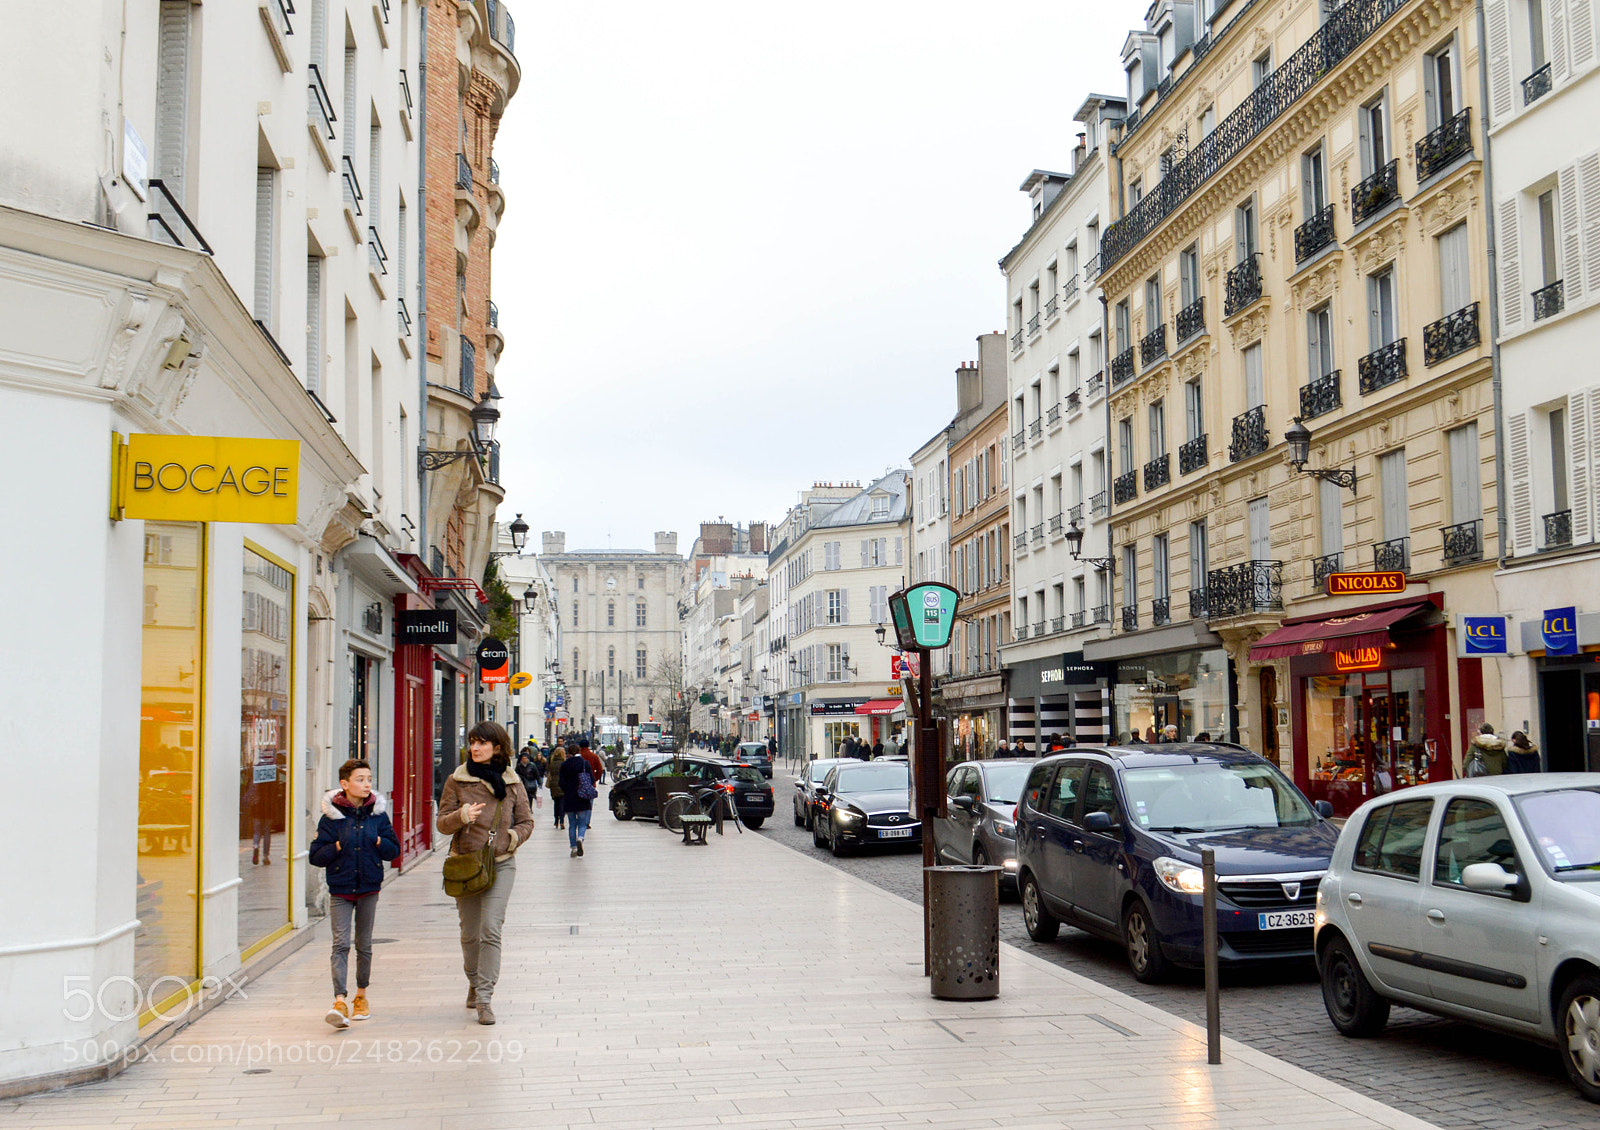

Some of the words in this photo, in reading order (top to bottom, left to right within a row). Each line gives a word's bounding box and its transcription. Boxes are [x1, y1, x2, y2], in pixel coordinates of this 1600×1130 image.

[134, 461, 289, 496] BOCAGE
[1337, 576, 1397, 590] NICOLAS
[406, 620, 449, 633] minelli
[1467, 625, 1502, 637] LCL
[1544, 617, 1573, 634] LCL
[481, 647, 507, 658] éram
[1338, 647, 1378, 665] NICOLAS
[1268, 912, 1317, 928] CZ-362-B
